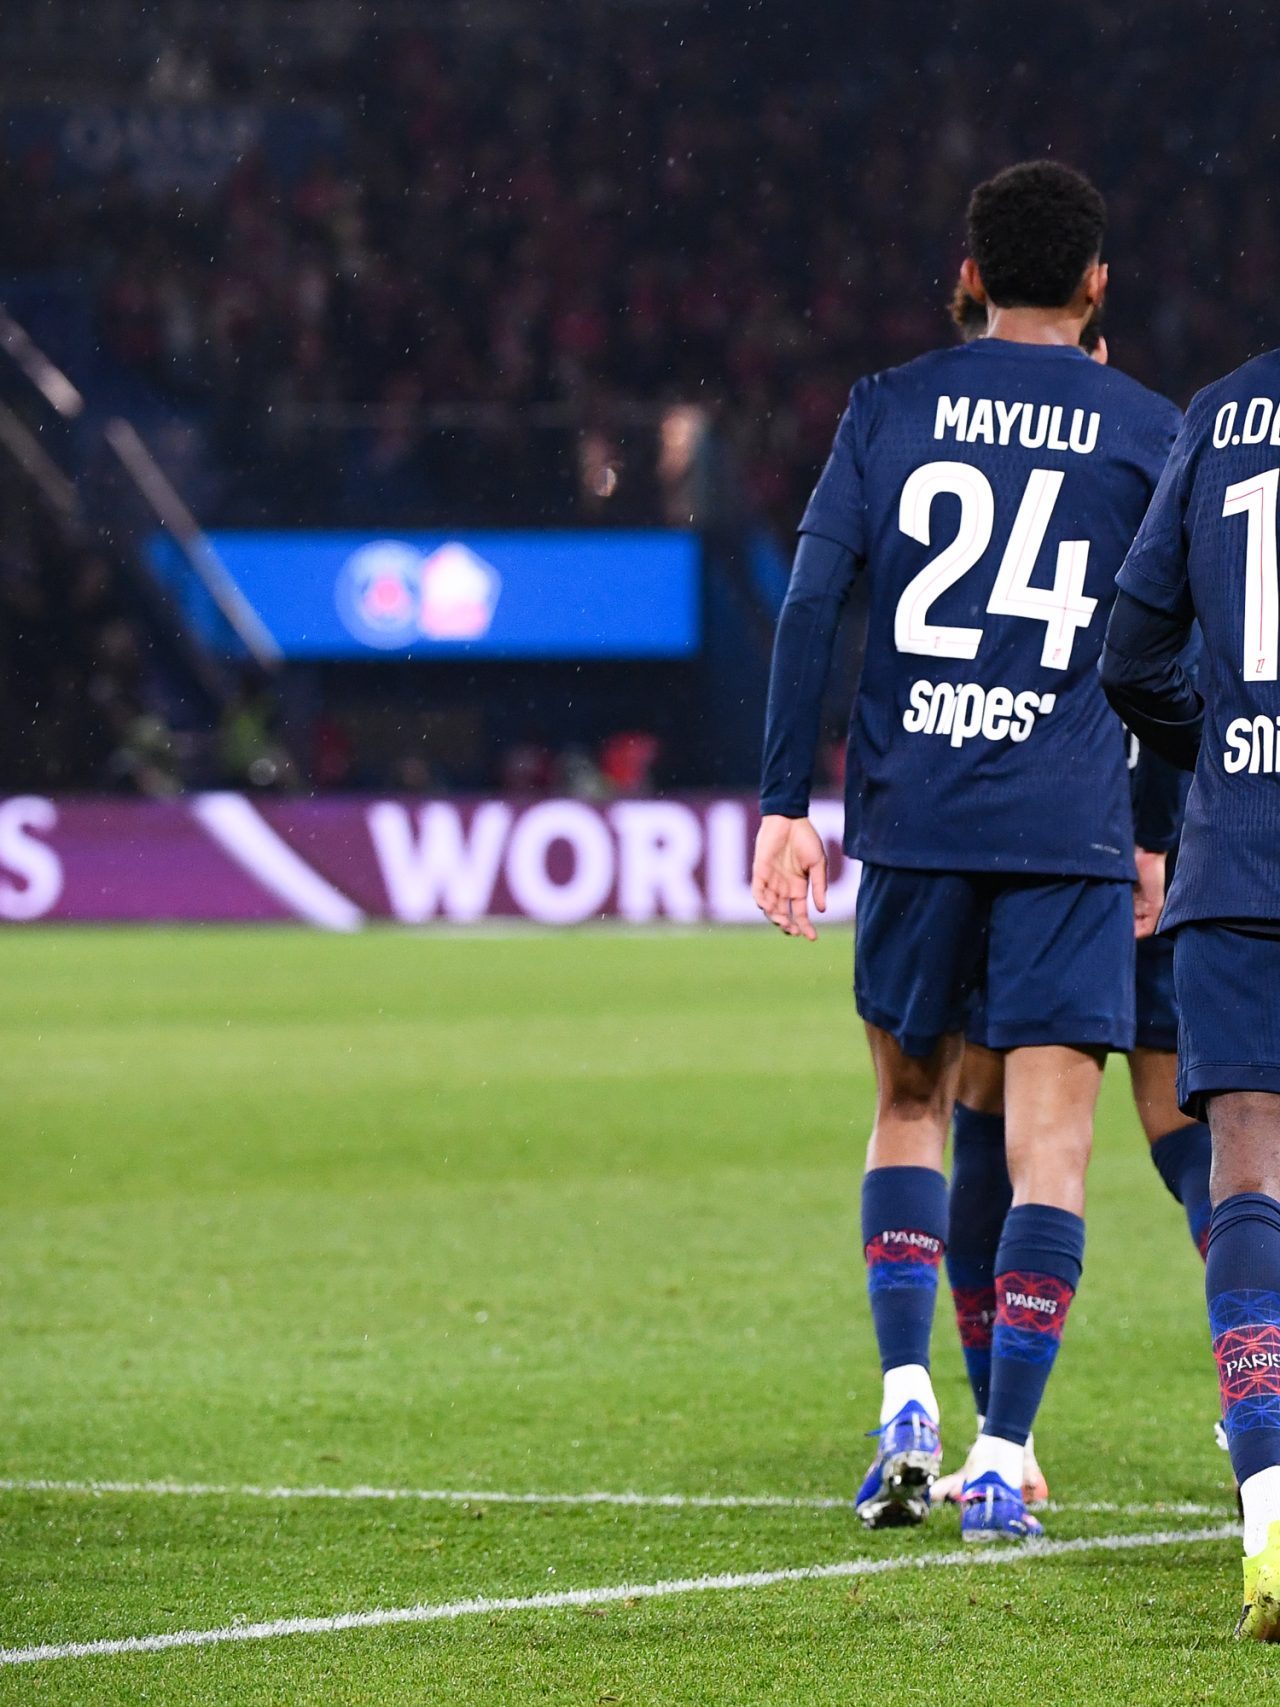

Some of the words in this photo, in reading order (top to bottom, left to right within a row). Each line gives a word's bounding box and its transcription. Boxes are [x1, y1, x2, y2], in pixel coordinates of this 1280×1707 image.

[934, 395, 1101, 454] MAYULU
[894, 460, 1099, 671] 24
[902, 679, 1044, 748] snipes
[882, 1230, 939, 1252] PARIS
[1005, 1291, 1058, 1315] PARIS
